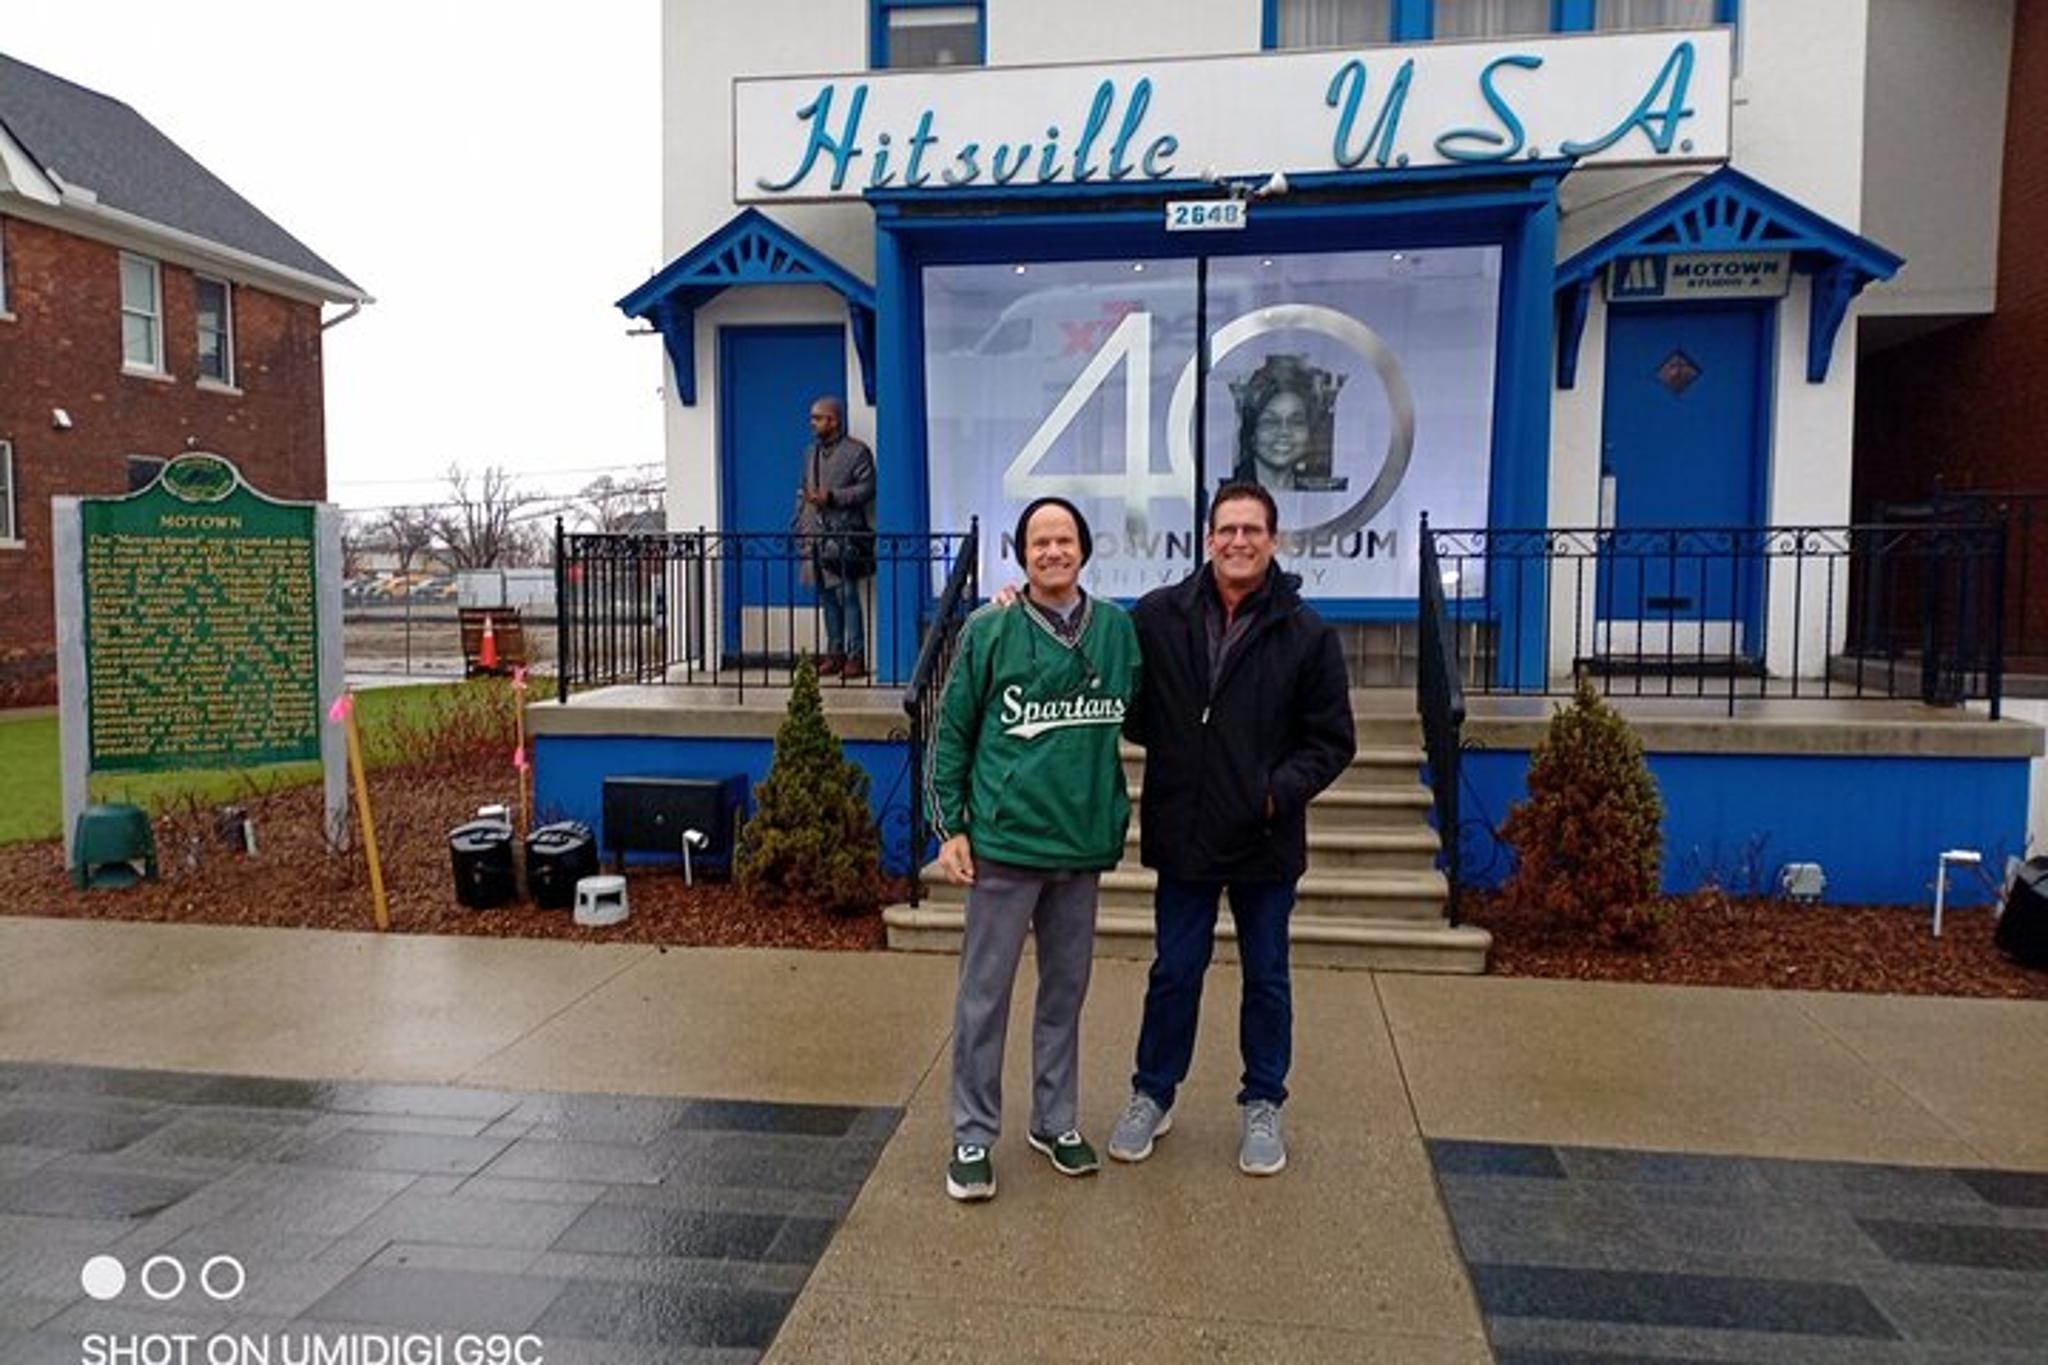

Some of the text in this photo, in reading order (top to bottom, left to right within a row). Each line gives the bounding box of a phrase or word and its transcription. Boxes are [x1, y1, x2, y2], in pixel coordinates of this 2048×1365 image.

[757, 72, 1180, 192] Hitsville
[1174, 204, 1239, 225] 2648
[1673, 260, 1779, 277] MOTOWN
[159, 514, 242, 529] MOTOWN
[1001, 685, 1126, 725] Spartans
